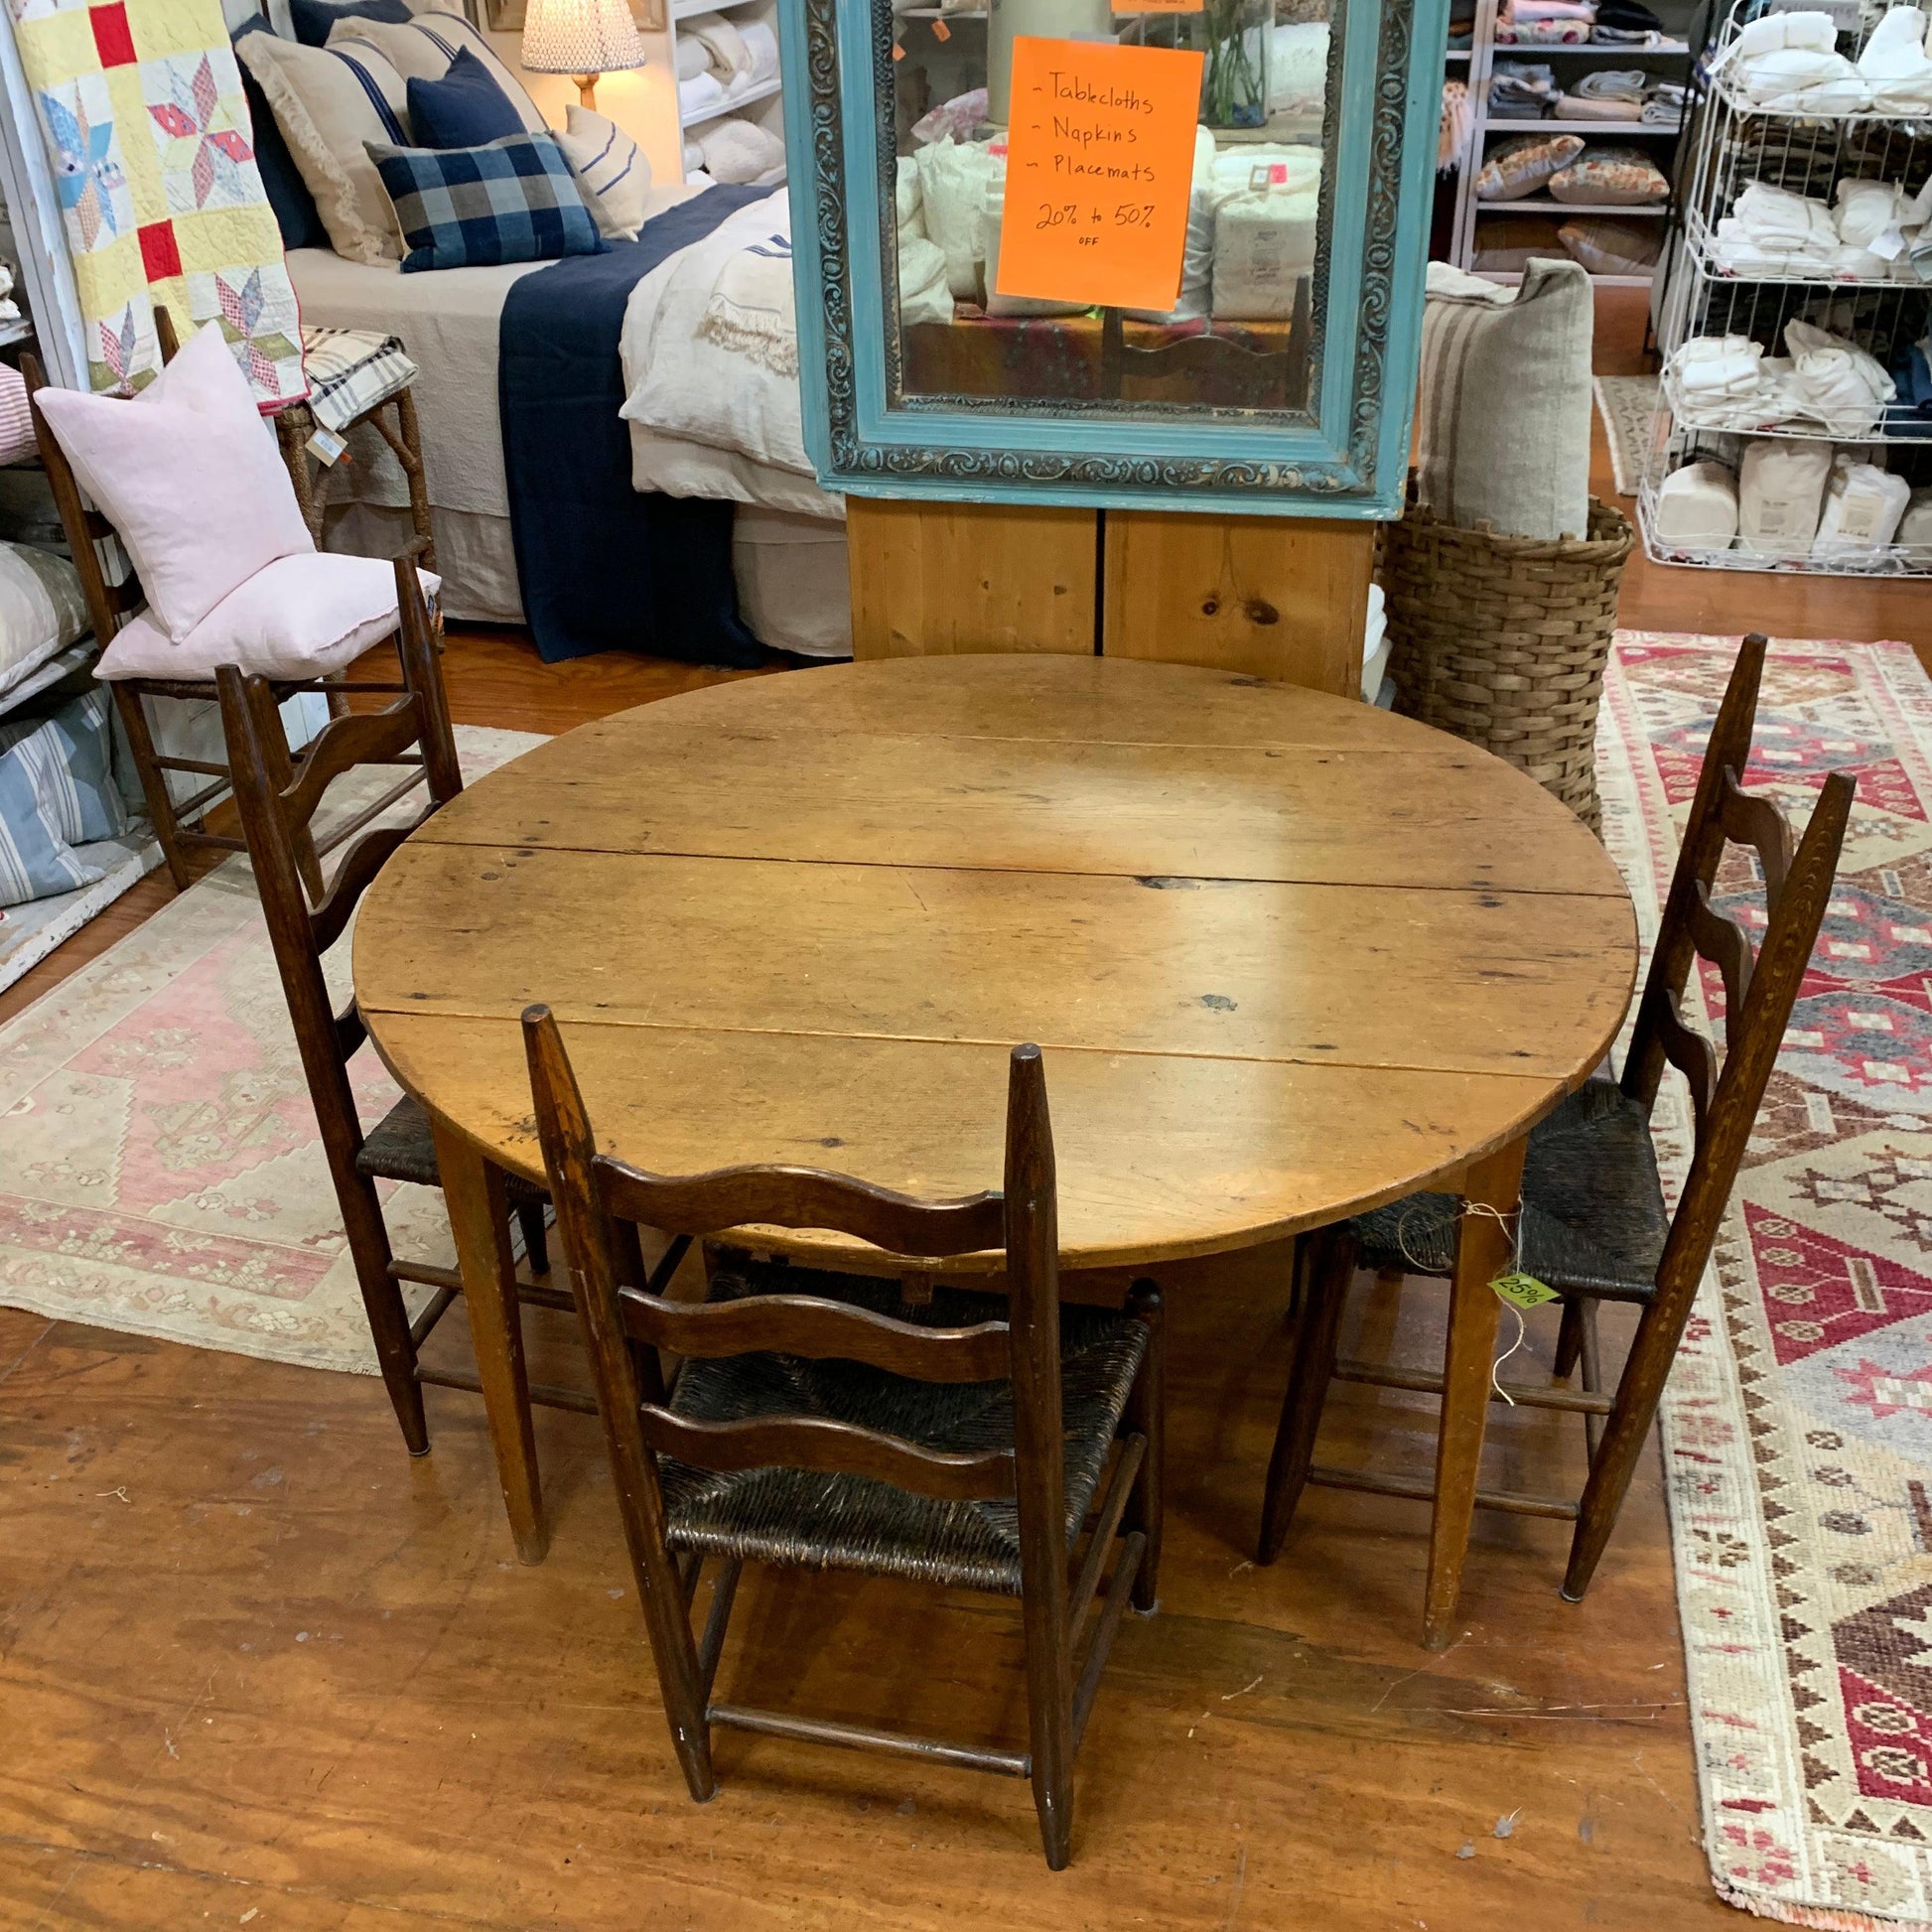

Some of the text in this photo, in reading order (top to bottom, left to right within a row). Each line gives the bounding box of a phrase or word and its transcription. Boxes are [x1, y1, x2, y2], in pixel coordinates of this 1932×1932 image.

[1048, 71, 1154, 114] Tablecloths
[1053, 115, 1138, 150] Napkins
[1053, 154, 1155, 182] Placemats
[1035, 203, 1155, 229] 20% to 50%
[1078, 236, 1100, 246] OFF
[1498, 1278, 1545, 1304] 25%
